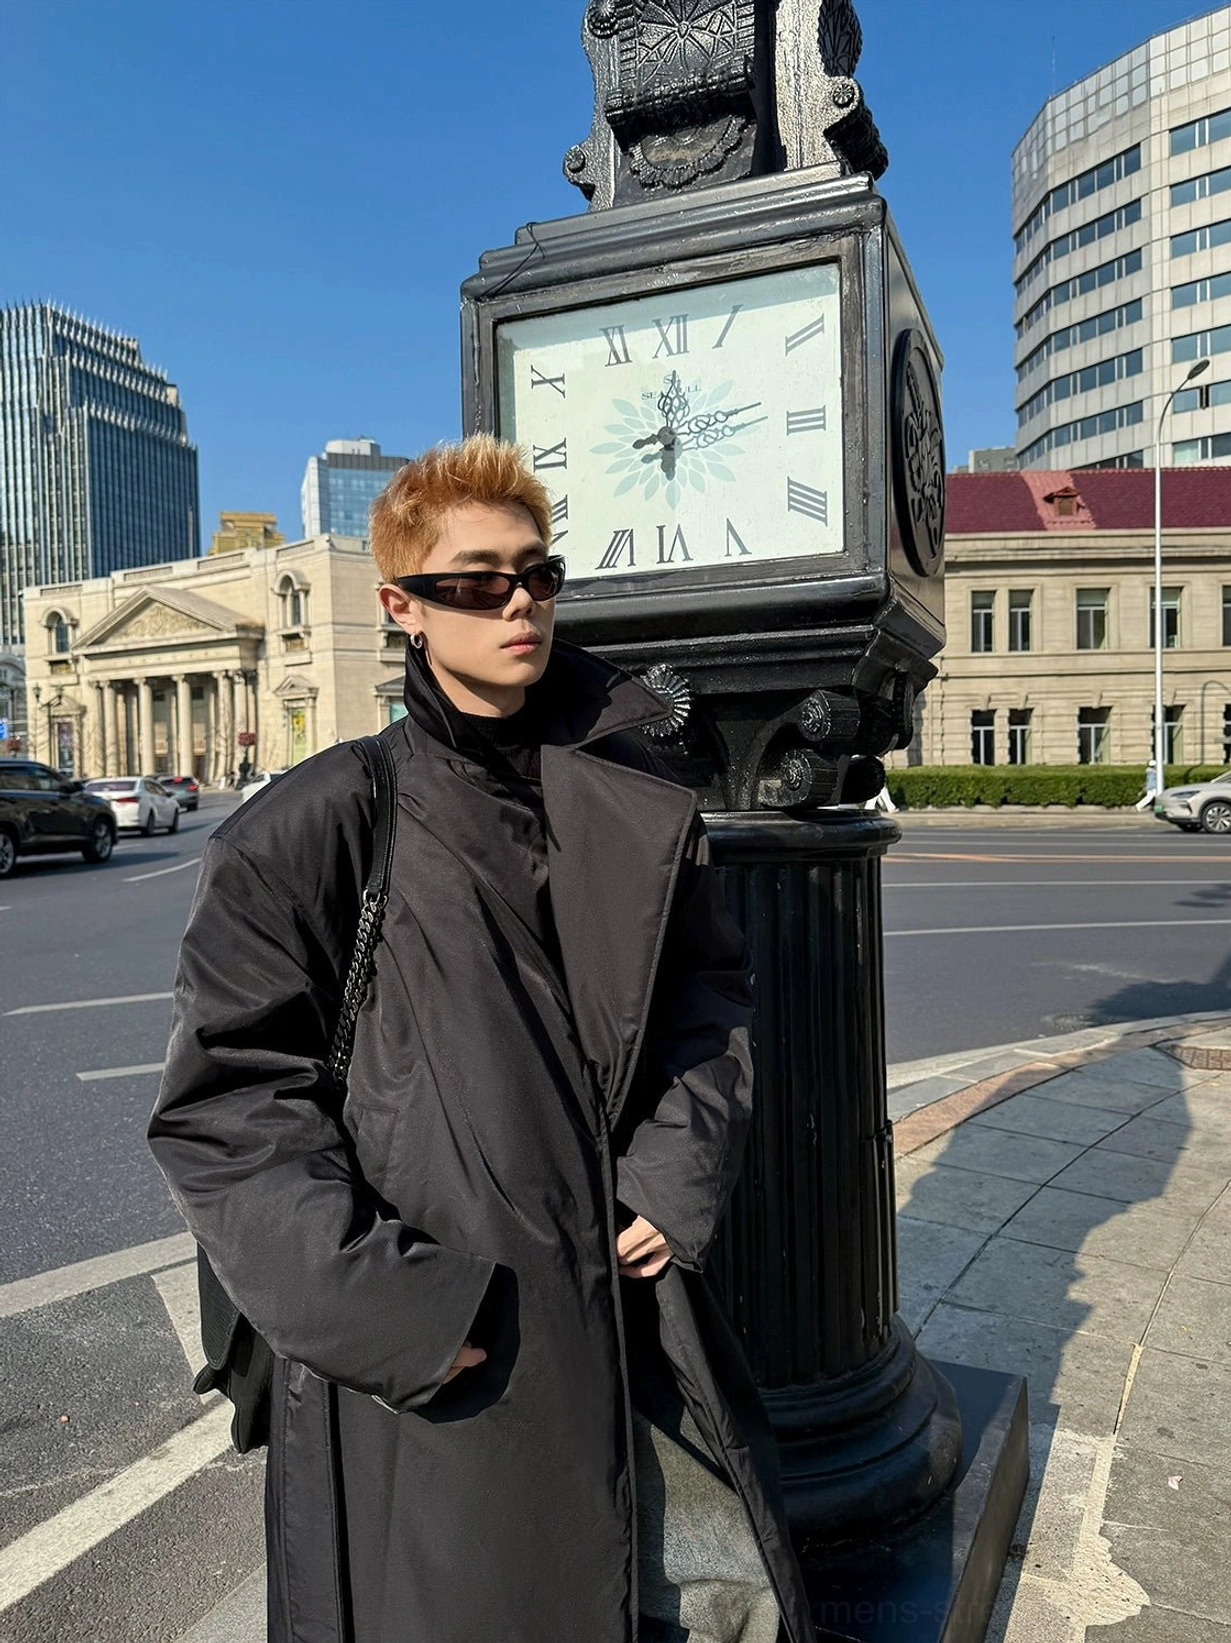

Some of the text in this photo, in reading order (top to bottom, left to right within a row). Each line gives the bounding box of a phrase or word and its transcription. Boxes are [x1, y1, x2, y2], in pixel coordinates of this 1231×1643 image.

[599, 324, 632, 367] XI
[652, 313, 690, 359] XII
[711, 304, 743, 349] I
[785, 313, 824, 357] II
[531, 364, 566, 398] X
[786, 405, 826, 436] III
[533, 437, 567, 473] IX
[787, 476, 828, 527] IIII
[595, 528, 636, 570] VII
[656, 523, 694, 564] VI
[725, 517, 752, 557] V
